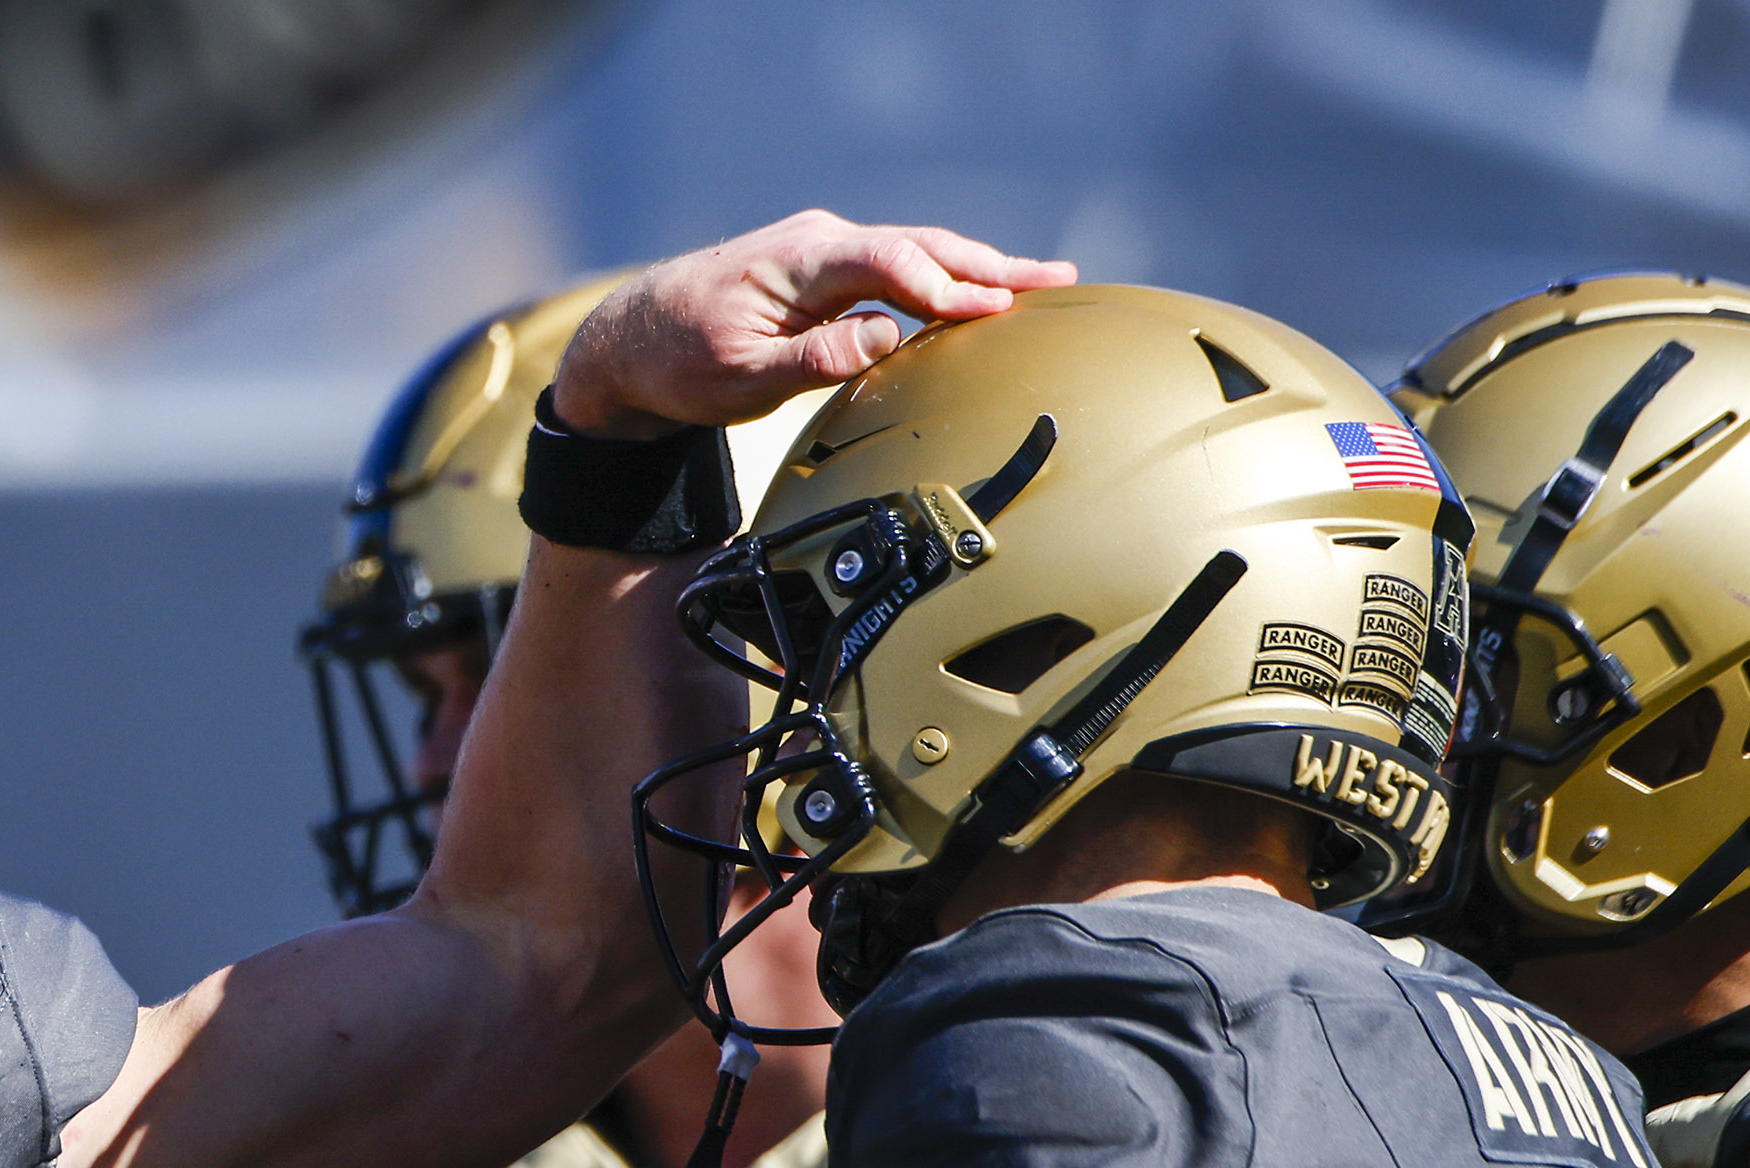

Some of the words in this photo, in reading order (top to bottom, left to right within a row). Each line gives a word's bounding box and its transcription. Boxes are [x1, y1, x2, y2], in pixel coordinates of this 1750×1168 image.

[1369, 580, 1424, 613] RANGER
[1268, 629, 1338, 661] RANGER
[1365, 615, 1421, 648] RANGER
[1259, 666, 1330, 697] RANGER
[1357, 651, 1413, 682] RANGER
[1344, 686, 1400, 714] RANGER
[1294, 733, 1430, 830] WEST
